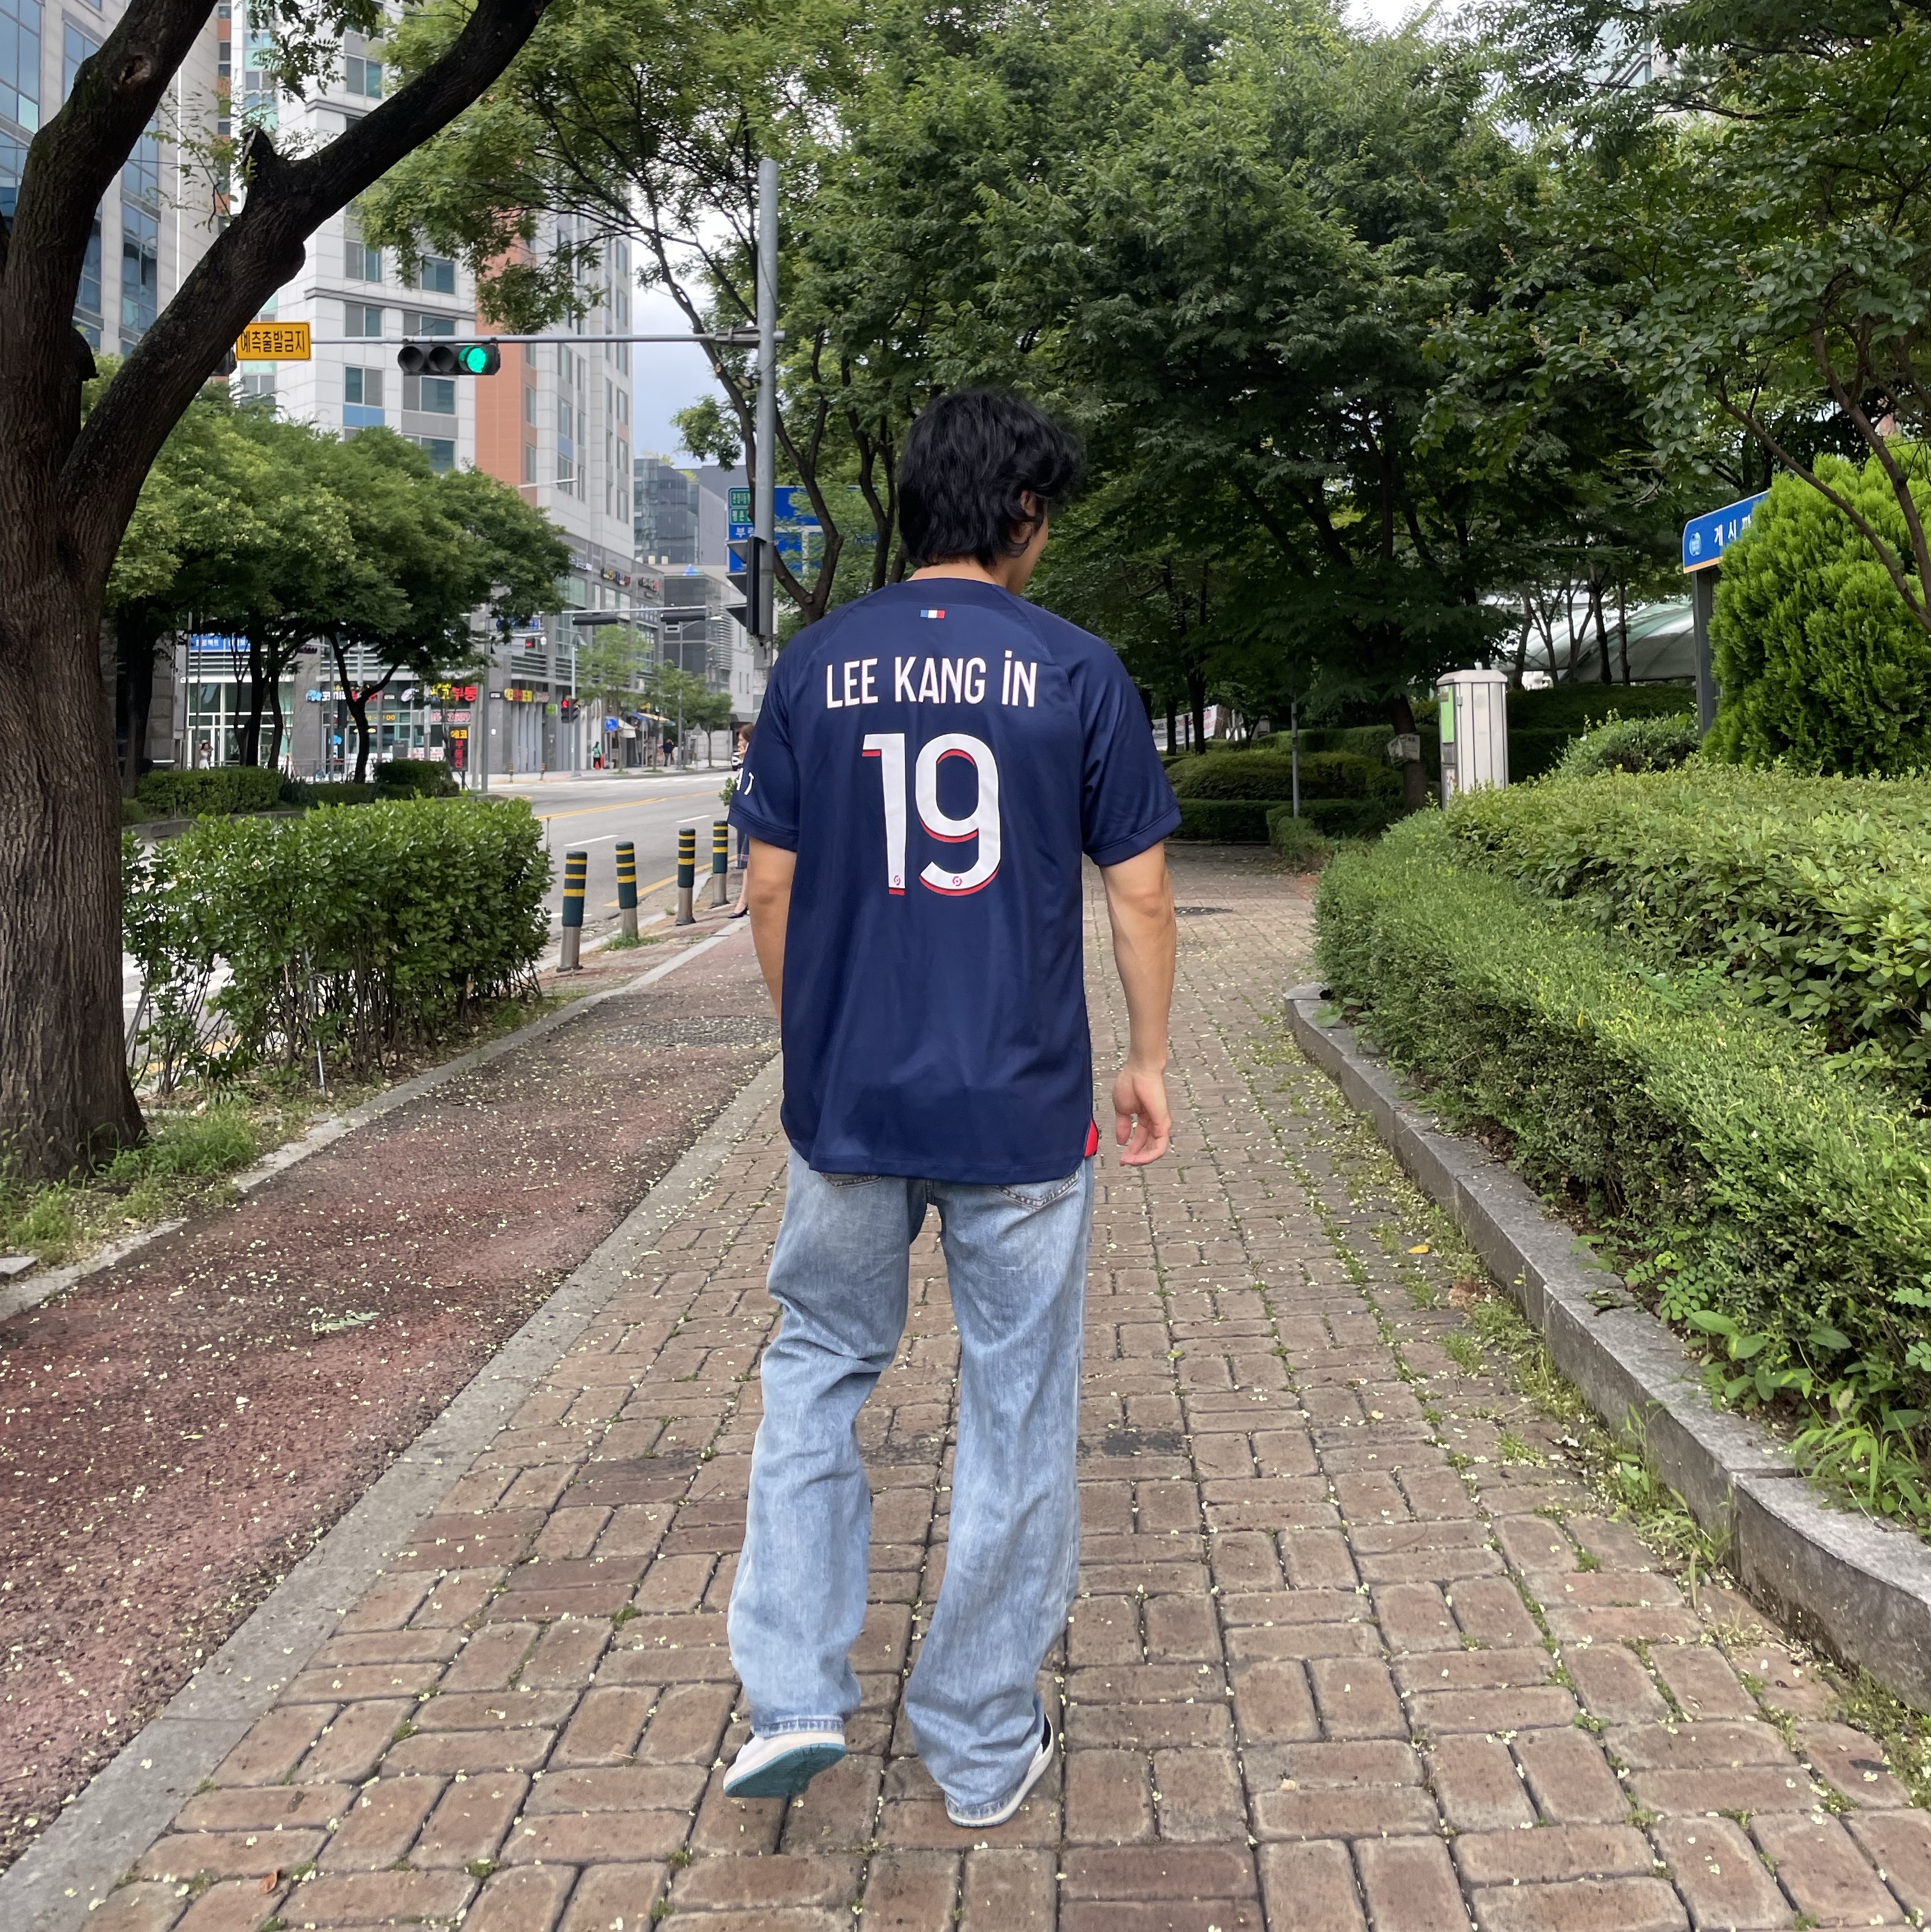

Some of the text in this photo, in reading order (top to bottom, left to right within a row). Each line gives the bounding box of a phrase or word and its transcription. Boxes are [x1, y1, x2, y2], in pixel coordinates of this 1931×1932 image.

[240, 330, 305, 353] 예측출발금지
[825, 657, 878, 709] LEE
[895, 656, 986, 705] KANG
[862, 732, 1001, 896] 19
